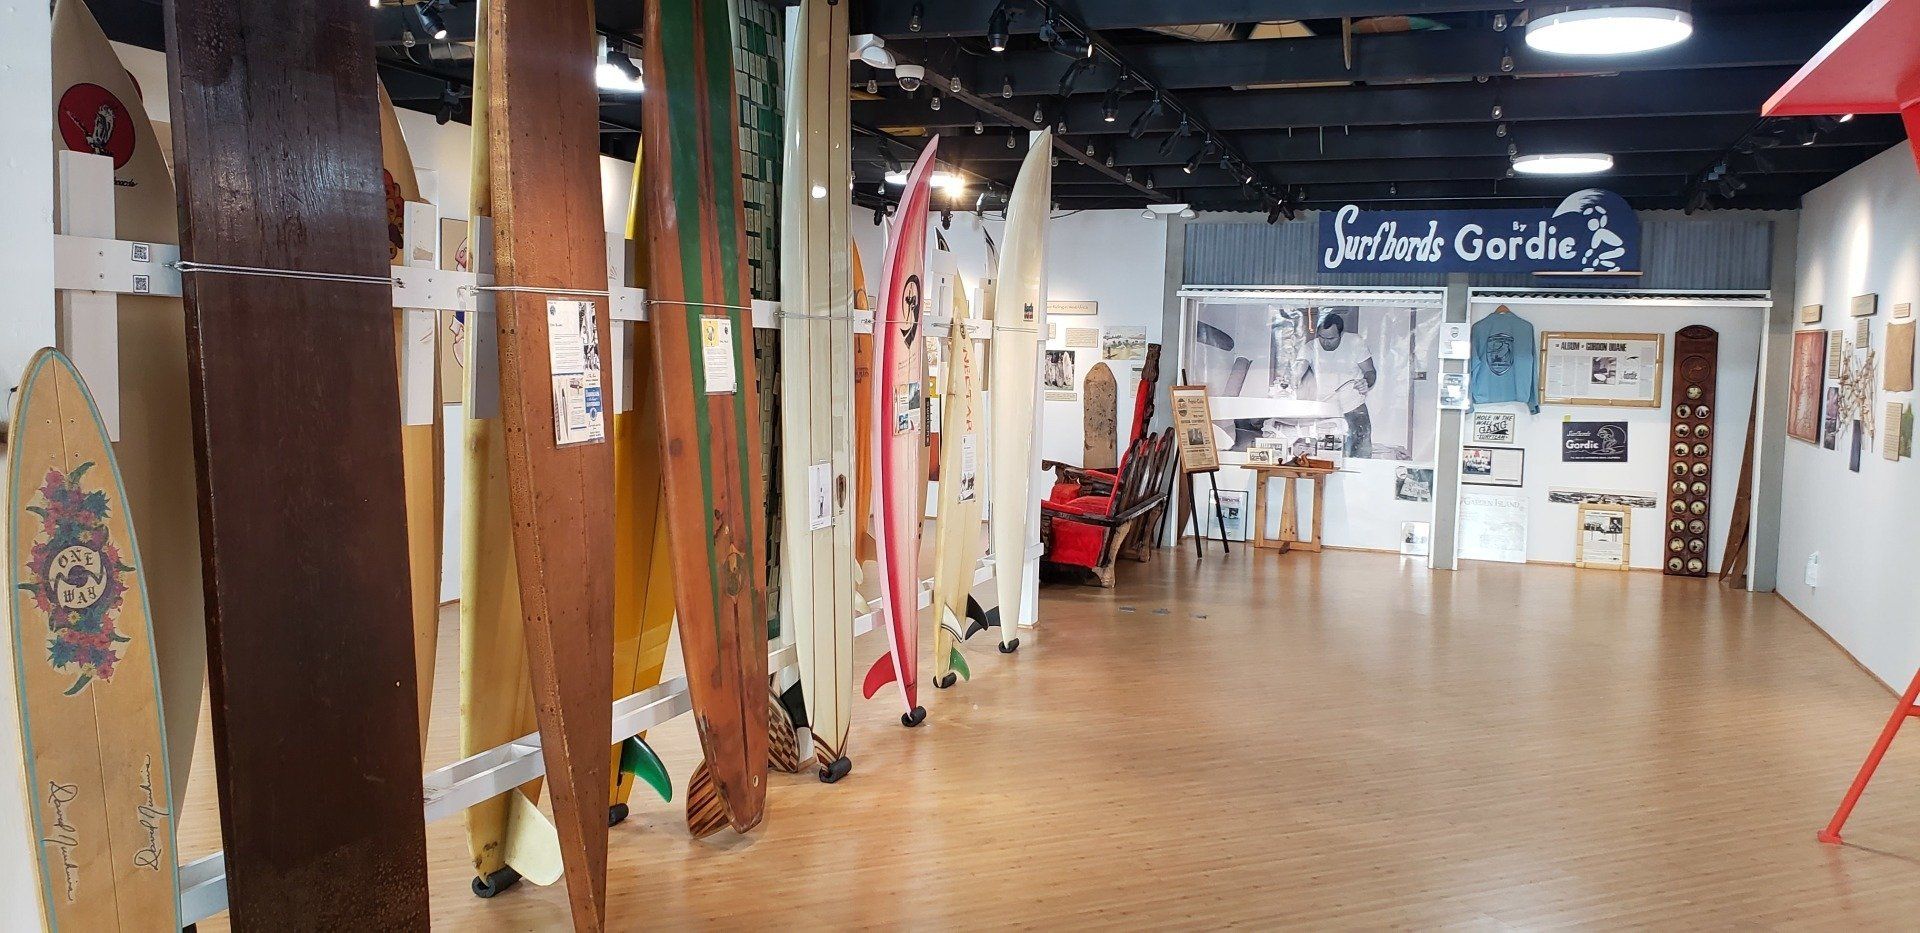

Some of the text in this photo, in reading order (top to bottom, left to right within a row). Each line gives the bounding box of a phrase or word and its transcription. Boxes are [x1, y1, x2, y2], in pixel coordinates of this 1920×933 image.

[1324, 204, 1445, 269] Surfbords
[1454, 220, 1577, 262] Gordie
[1586, 343, 1608, 351] GORDON
[1479, 421, 1508, 434] GANG
[1565, 440, 1599, 449] Gordie
[58, 550, 93, 568] ONE
[63, 586, 97, 604] WAY
